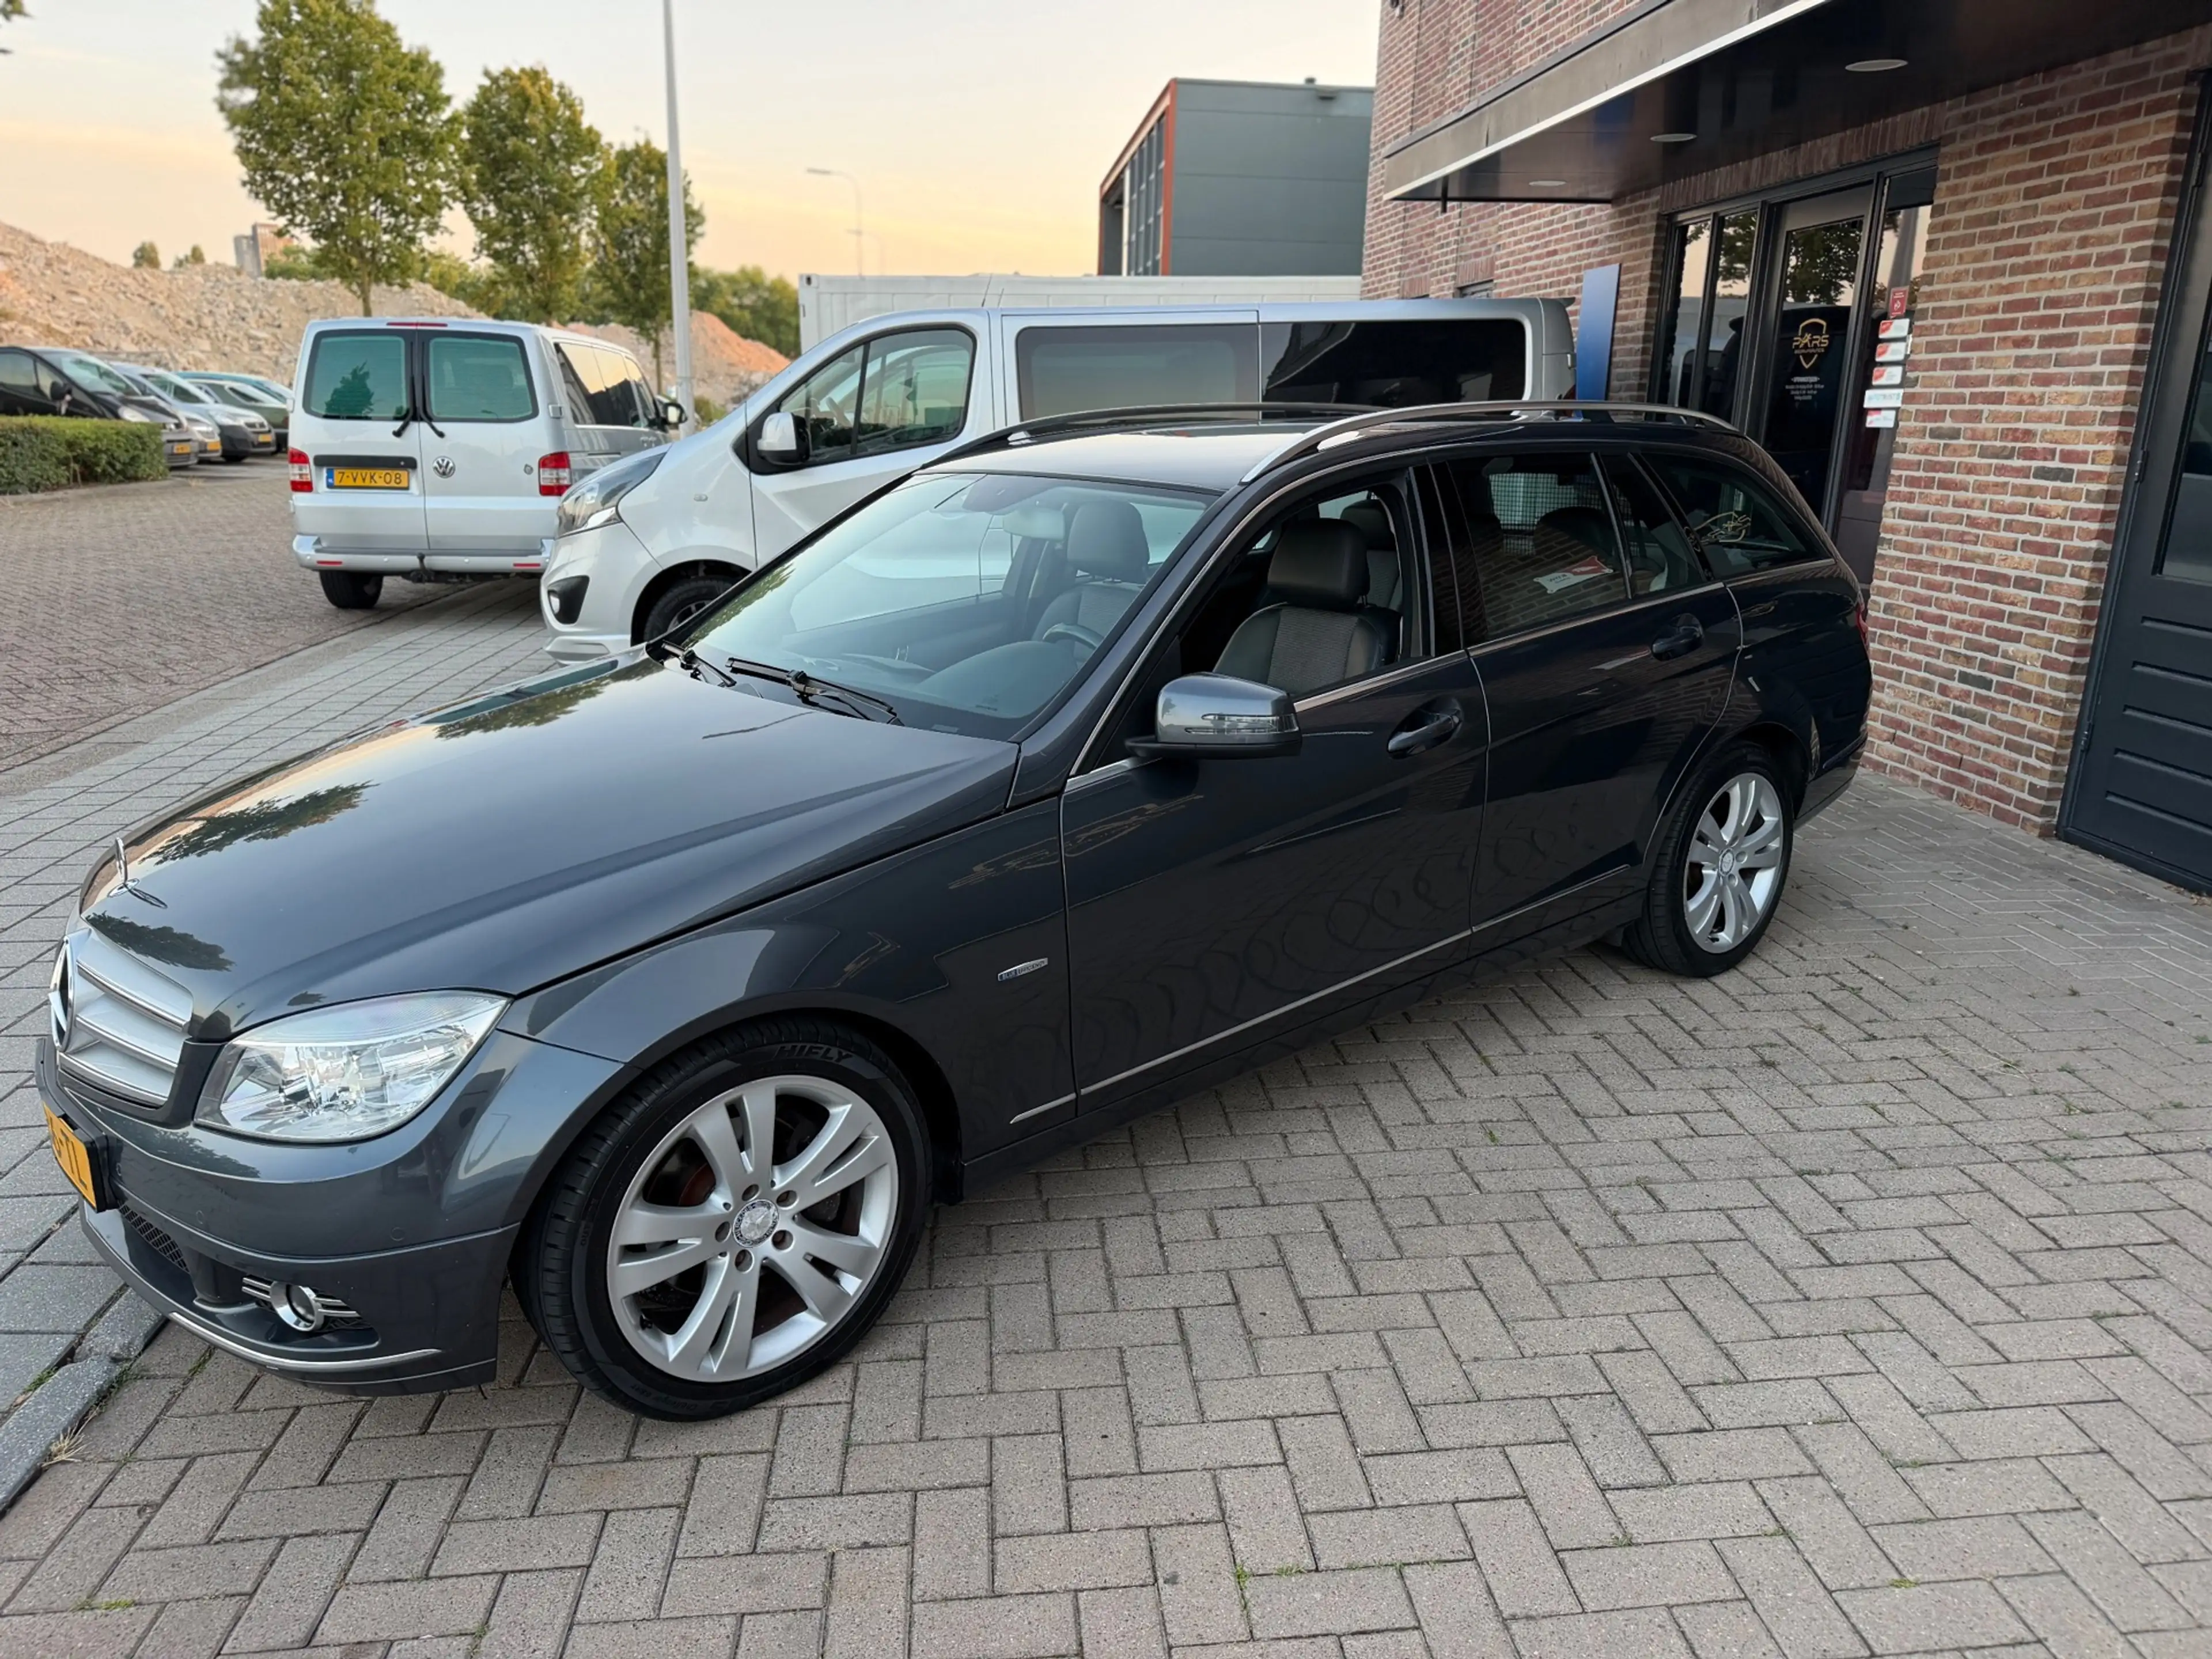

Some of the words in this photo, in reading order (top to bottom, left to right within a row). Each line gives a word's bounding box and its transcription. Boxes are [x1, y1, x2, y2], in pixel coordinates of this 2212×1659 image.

[1792, 332, 1830, 349] PARS
[338, 471, 402, 485] 7-VVK-08
[774, 1044, 853, 1063] HIFLY
